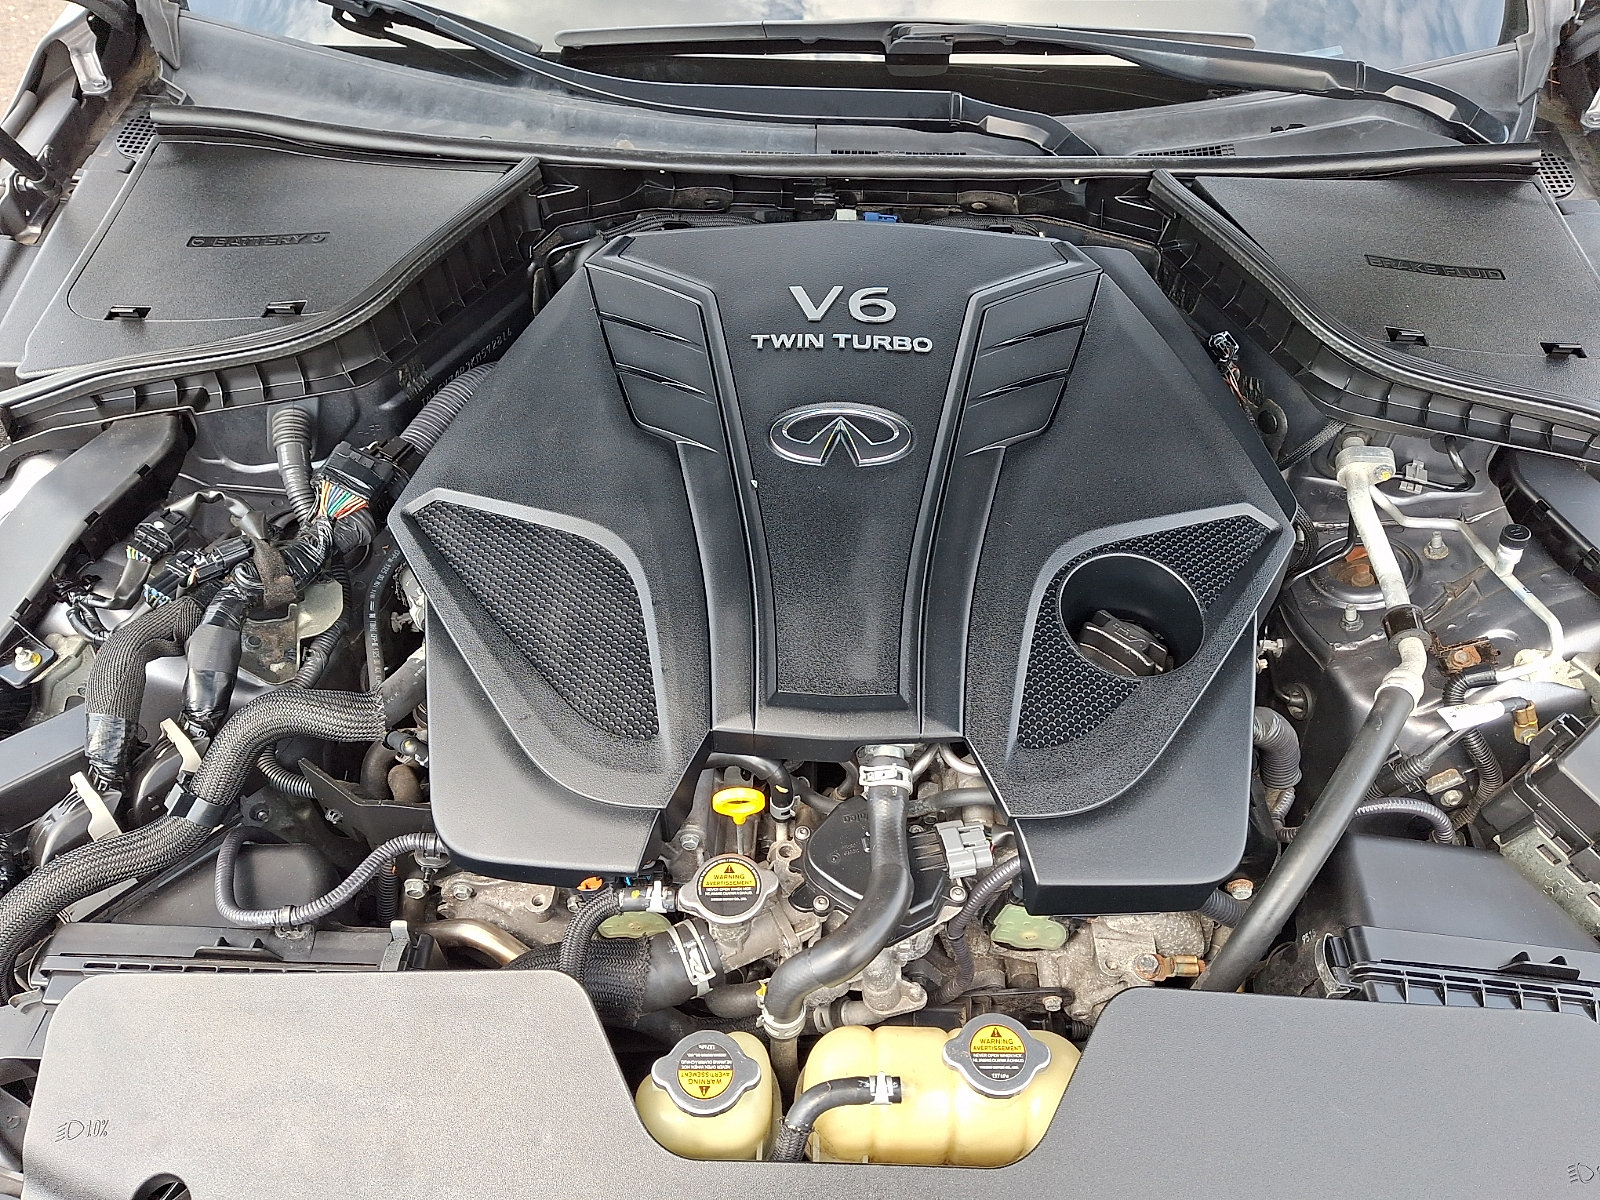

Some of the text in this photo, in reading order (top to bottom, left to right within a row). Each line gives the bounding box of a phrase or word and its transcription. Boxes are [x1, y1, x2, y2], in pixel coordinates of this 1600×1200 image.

[212, 234, 308, 247] BATTERY
[1367, 255, 1503, 280] BRAKE FLUID
[788, 285, 897, 323] V6
[750, 333, 933, 353] TWIN TURBO
